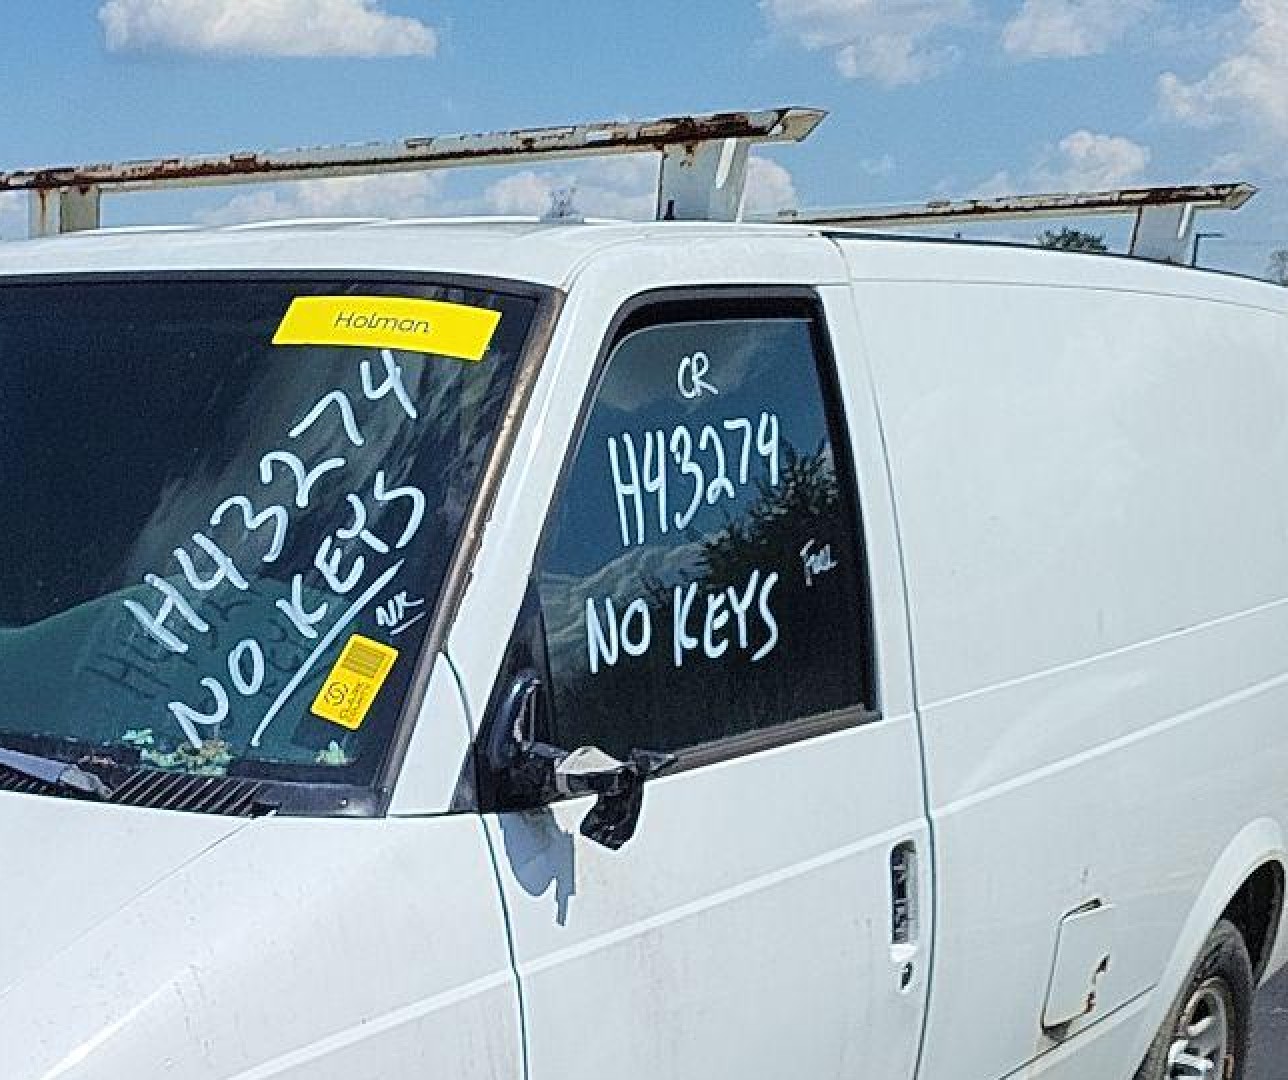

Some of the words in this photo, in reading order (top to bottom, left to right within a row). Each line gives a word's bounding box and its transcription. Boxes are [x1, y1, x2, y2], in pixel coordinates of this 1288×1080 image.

[333, 311, 430, 333] Holman
[677, 351, 719, 399] CR
[123, 349, 417, 653] H43274
[607, 411, 779, 547] H43274
[168, 639, 265, 749] NO
[275, 470, 426, 639] KEYS
[586, 596, 652, 675] NO
[673, 568, 779, 667] KEYS
